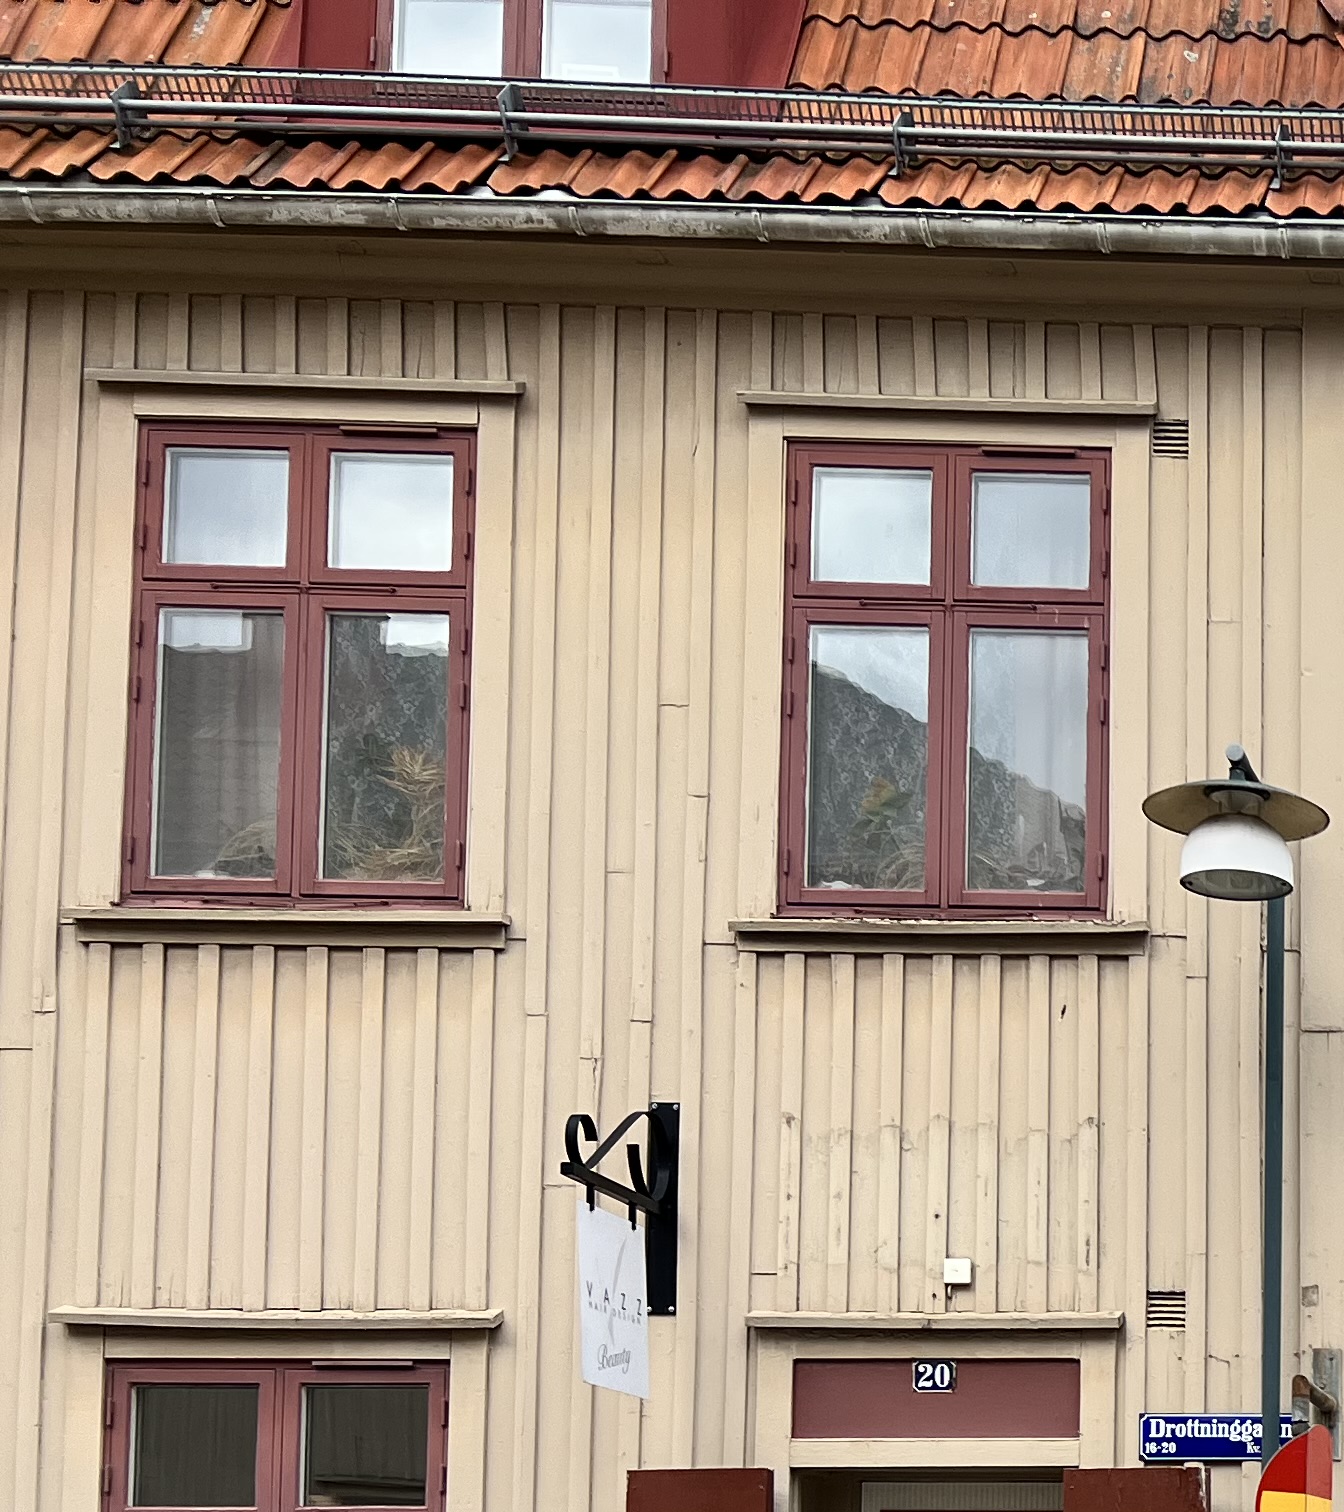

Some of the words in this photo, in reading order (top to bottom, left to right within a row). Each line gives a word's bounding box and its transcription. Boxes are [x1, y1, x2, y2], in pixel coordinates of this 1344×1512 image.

[598, 1343, 631, 1374] Beauty
[917, 1363, 951, 1388] 20
[1149, 1418, 1293, 1441] Drottninggan
[1145, 1441, 1177, 1454] 16-20
